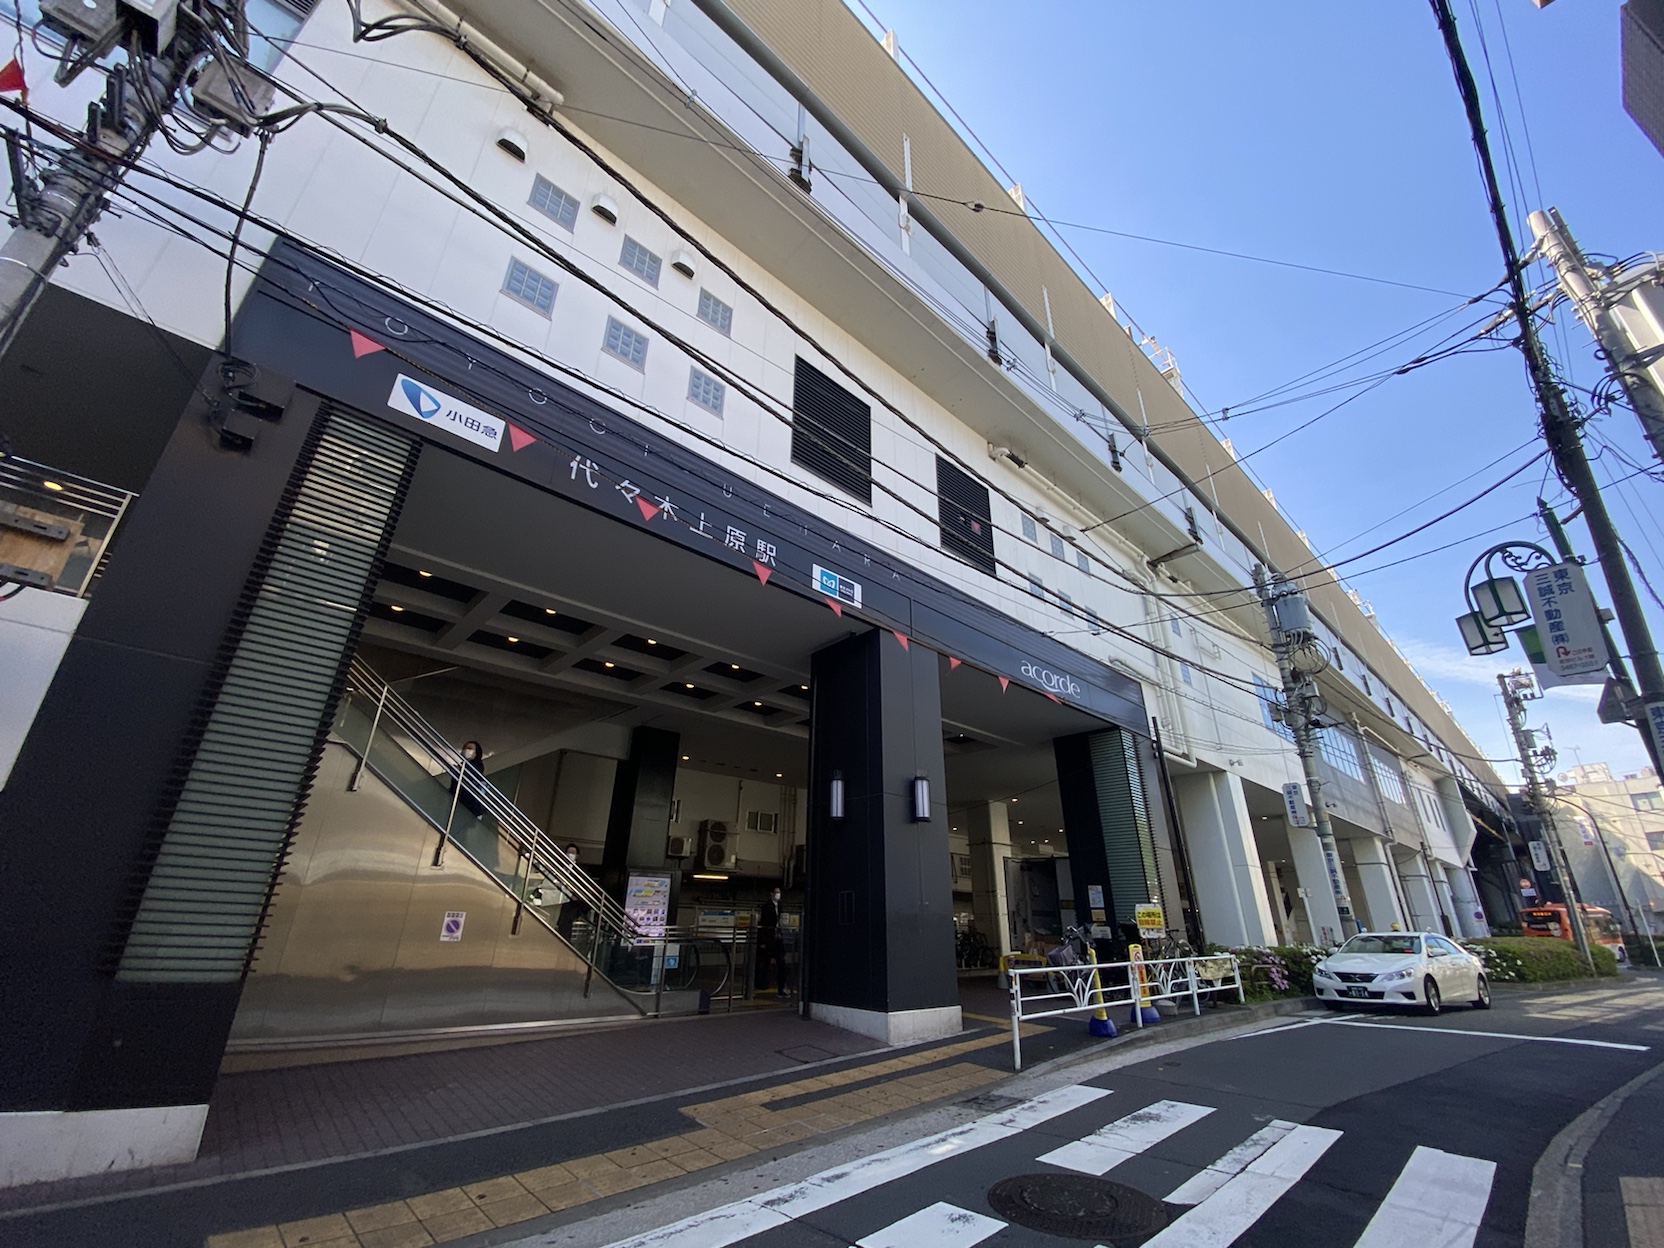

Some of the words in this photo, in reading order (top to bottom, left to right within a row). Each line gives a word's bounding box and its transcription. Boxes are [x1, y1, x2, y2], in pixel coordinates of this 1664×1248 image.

[444, 409, 498, 441] 小田急
[569, 454, 777, 567] 代々木上原駅
[1552, 568, 1575, 596] 東京
[1020, 659, 1081, 699] acorde
